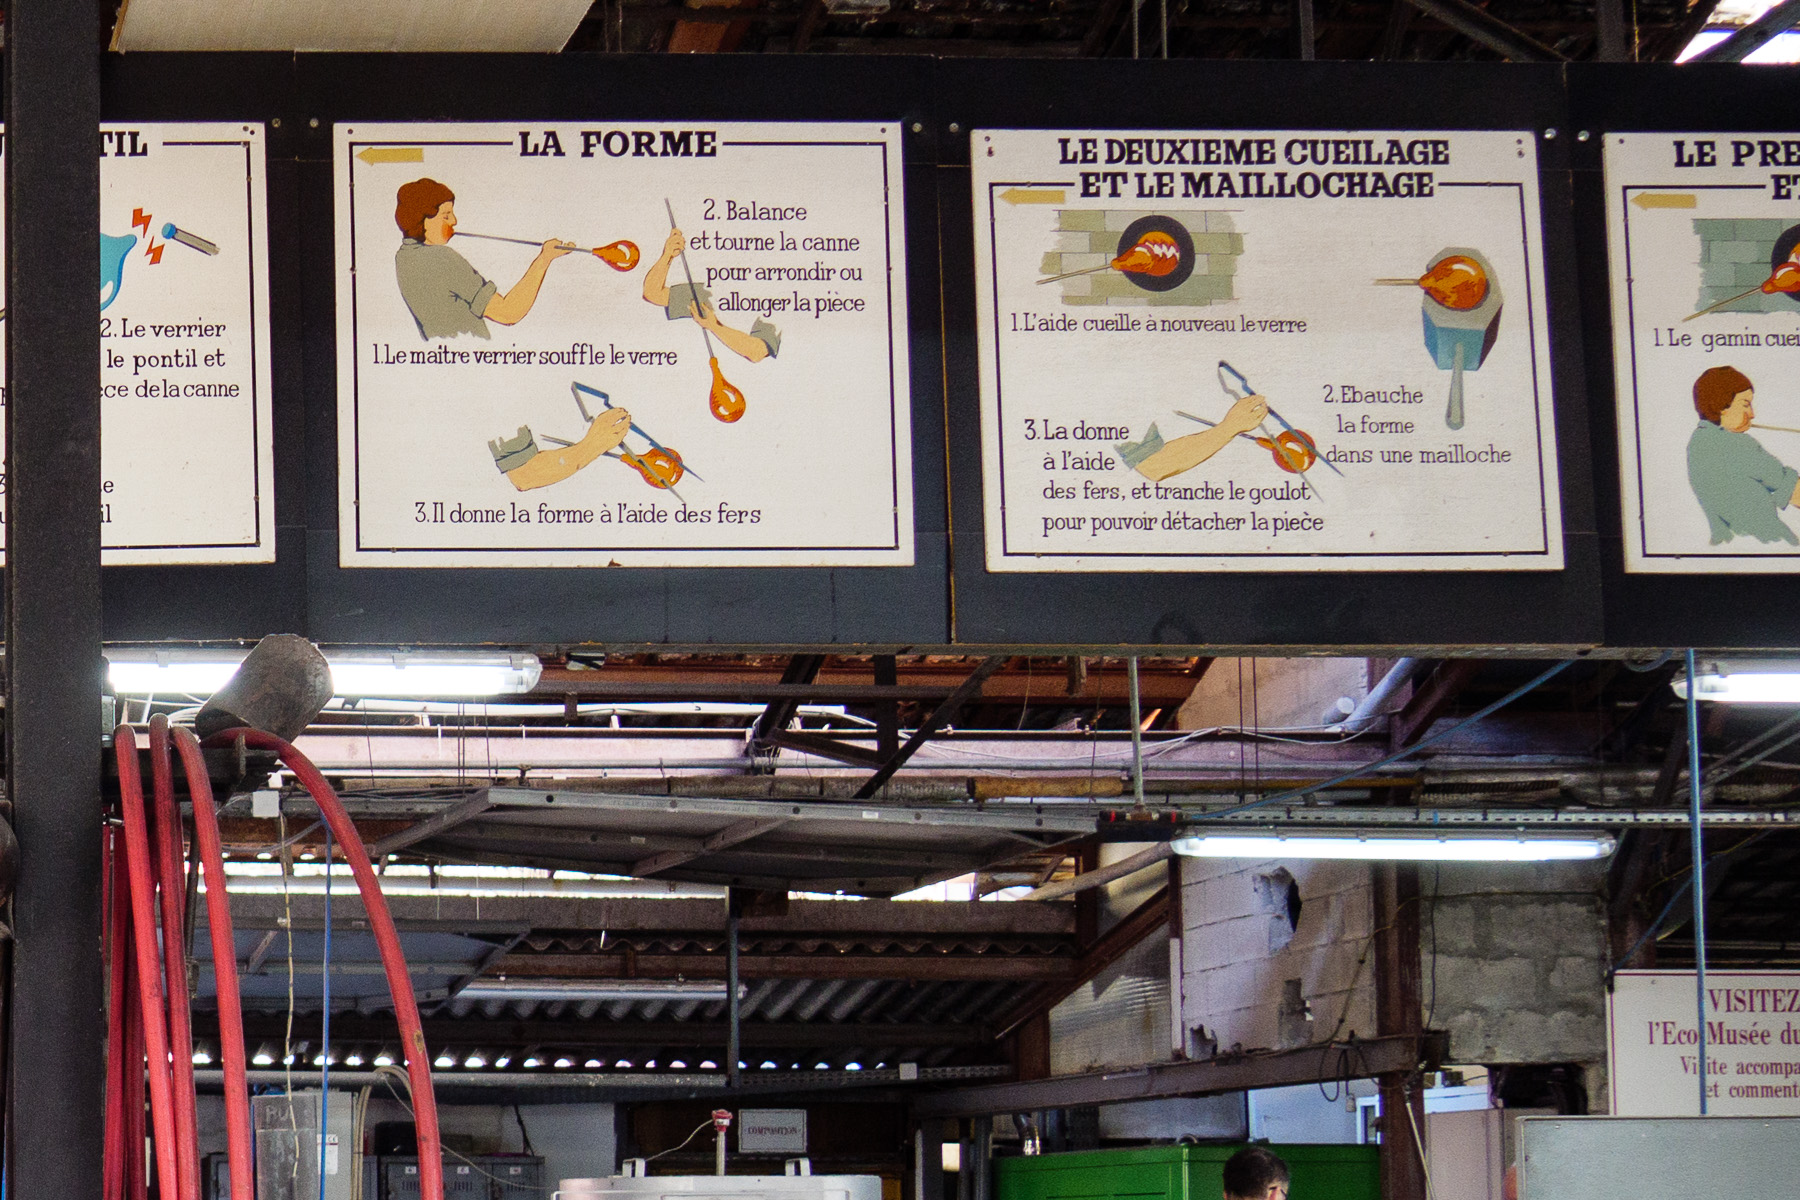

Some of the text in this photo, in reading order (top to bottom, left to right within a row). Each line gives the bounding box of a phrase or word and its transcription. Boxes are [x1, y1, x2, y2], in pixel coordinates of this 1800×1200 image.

[519, 130, 717, 158] LA FORME
[1058, 138, 1450, 166] LE DEUXIEME CUEILAGE
[1673, 140, 1717, 168] LE
[1079, 171, 1434, 199] ET LE MAILLOCHAGE
[726, 200, 807, 221] Balance
[690, 230, 860, 251] et tourne canne
[706, 261, 862, 288] pour arrondir ou
[718, 291, 865, 319] allonger la pièce
[121, 317, 226, 338] Le verrier
[1083, 313, 1307, 333] cueille nouveau verre
[1667, 328, 1692, 347] Le
[1701, 327, 1762, 353] gamin
[107, 348, 226, 376] le pontil et
[410, 343, 677, 365] maître verrier souffle le verre
[183, 384, 240, 397] canne
[1072, 420, 1129, 440] donne
[1336, 414, 1414, 434] la forme
[1043, 450, 1115, 471] à l'aide
[1325, 443, 1511, 465] dans une mailloche
[1043, 479, 1076, 499] des
[1131, 482, 1152, 499] et
[1154, 481, 1224, 500] tranche
[1228, 480, 1245, 500] le
[1249, 480, 1311, 505] goulot
[449, 502, 761, 524] donne la forme à l'aide des fers
[1042, 511, 1246, 538] pour pouvoir détacher
[1708, 989, 1800, 1013] VISITEZ
[1648, 1021, 1698, 1045] l'Eco
[1707, 1021, 1771, 1045] Musée
[1681, 1056, 1727, 1074] Viite
